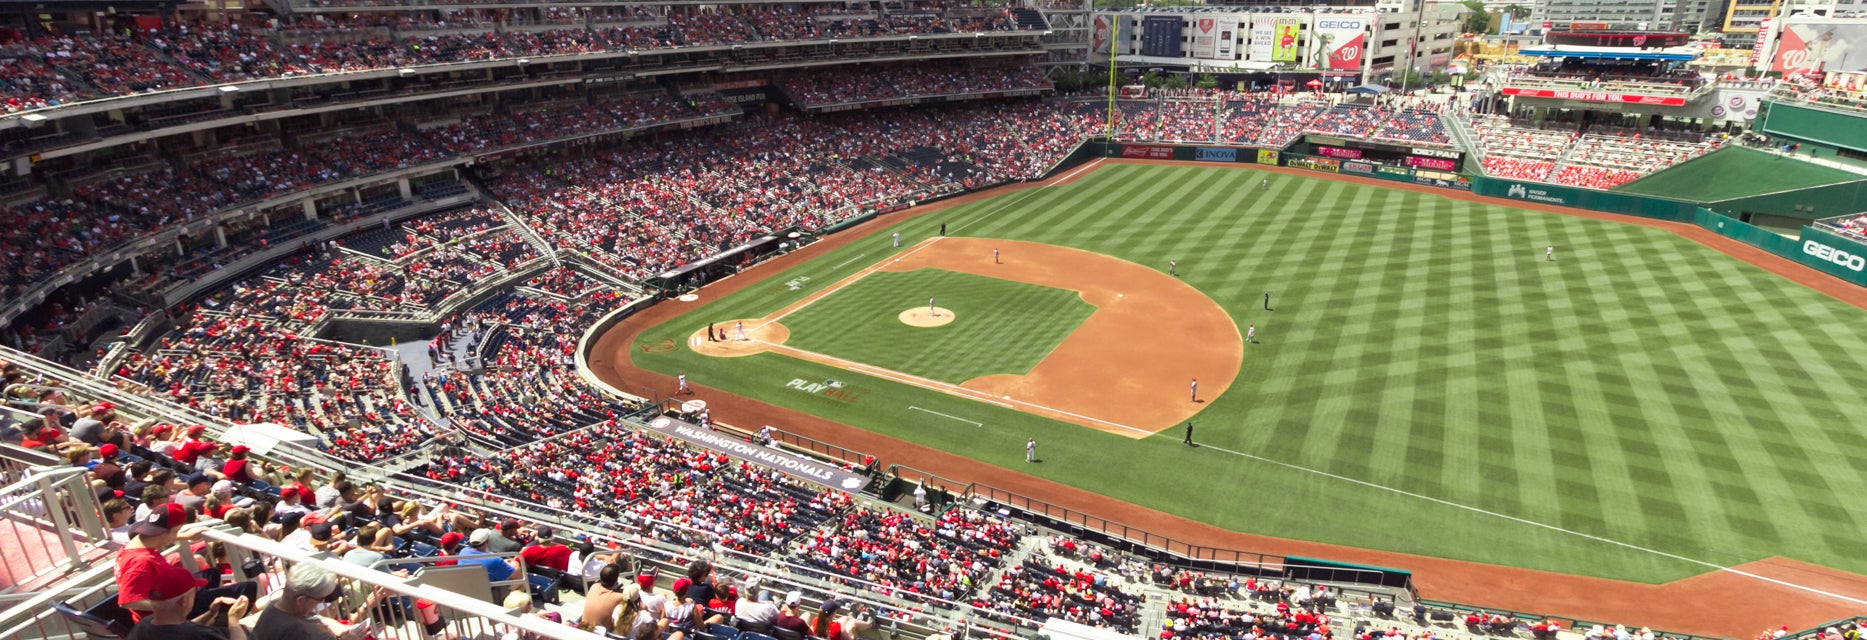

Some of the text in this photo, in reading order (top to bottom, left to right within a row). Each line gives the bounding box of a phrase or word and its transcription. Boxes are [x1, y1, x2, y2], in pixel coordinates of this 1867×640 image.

[1319, 20, 1361, 30] GEICO
[1570, 91, 1590, 99] BUD'S
[1592, 92, 1606, 100] FOR
[1205, 149, 1235, 158] INOVA
[1436, 150, 1460, 159] FAN
[1802, 239, 1866, 271] GEICO
[785, 378, 828, 393] PLAY
[674, 425, 834, 481] WASHINGTON NATIONALS
